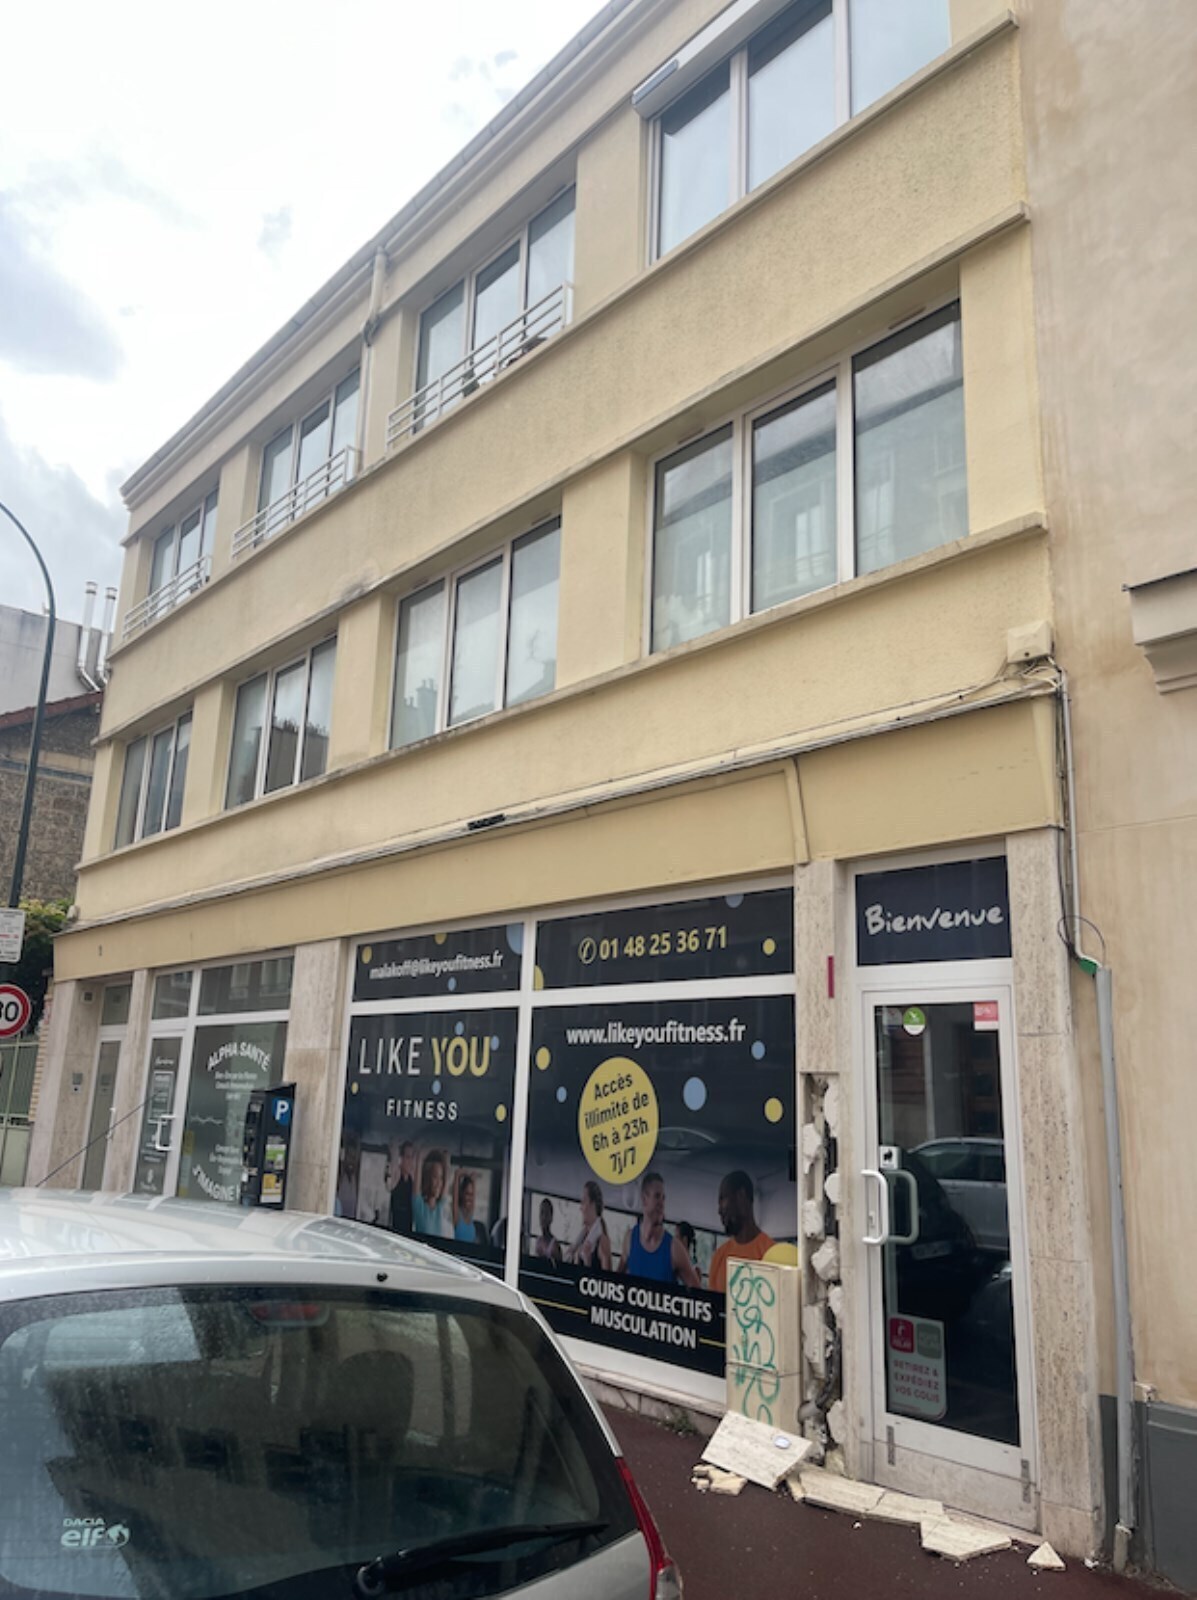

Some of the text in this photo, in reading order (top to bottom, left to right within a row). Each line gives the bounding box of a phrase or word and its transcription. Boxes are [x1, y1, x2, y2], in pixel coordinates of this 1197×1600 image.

[865, 904, 1003, 935] Bienvenue
[600, 926, 727, 960] 01 48 25 36 71
[369, 950, 503, 979] malakoff@likeyoufitness.fr
[0, 1001, 19, 1022] 0
[566, 1018, 746, 1048] www.likeyoufitness.fr
[359, 1036, 491, 1077] LIKE YOU
[594, 1073, 633, 1100] Accès
[275, 1100, 289, 1120] P
[386, 1099, 458, 1121] FITNESS
[584, 1092, 649, 1130] illimité de
[592, 1118, 648, 1152] 6h à 23h
[579, 1277, 712, 1322] COURS COLLECTIFS
[590, 1306, 696, 1349] MUSCULATION
[60, 1527, 106, 1547] elf
[63, 1518, 106, 1527] DACIA
